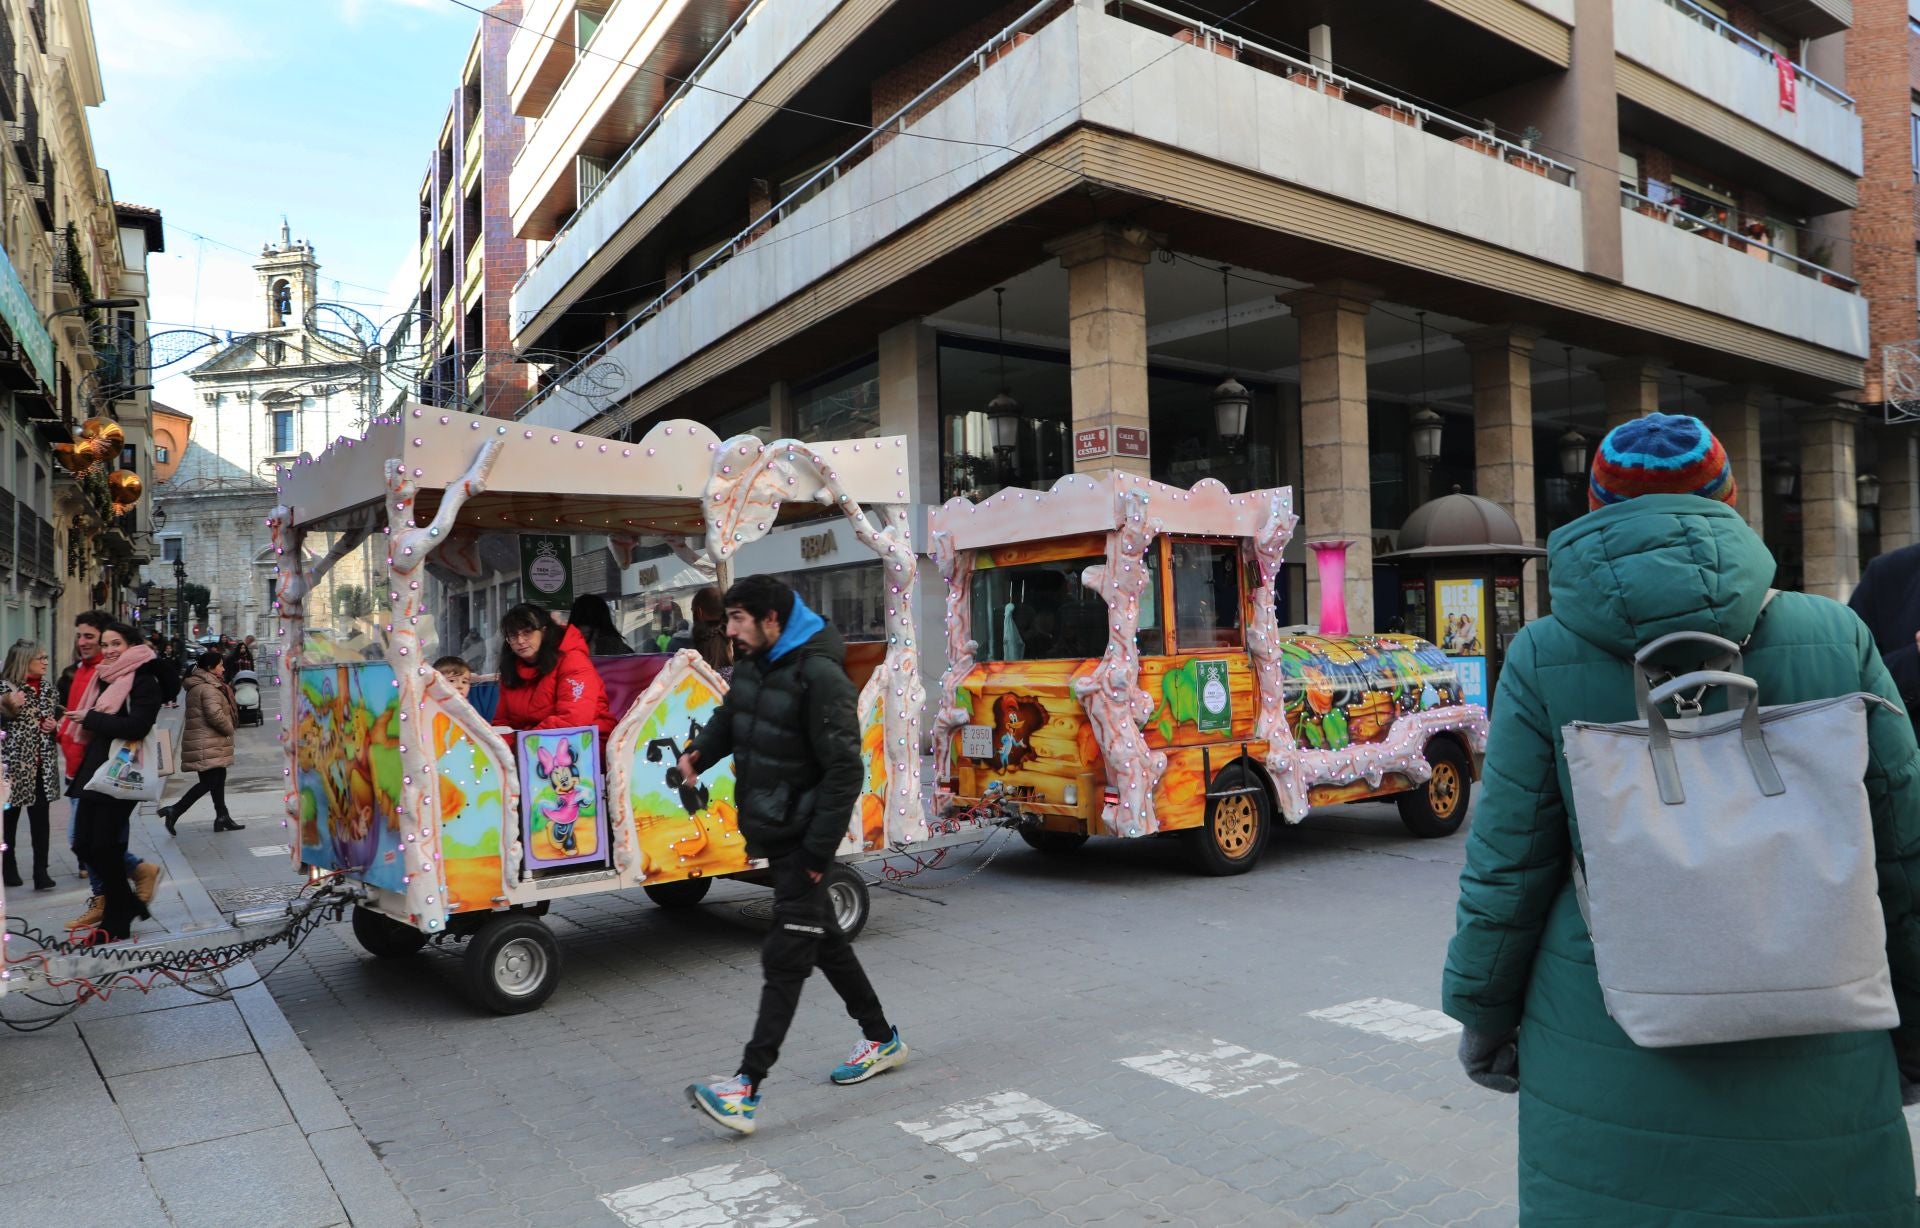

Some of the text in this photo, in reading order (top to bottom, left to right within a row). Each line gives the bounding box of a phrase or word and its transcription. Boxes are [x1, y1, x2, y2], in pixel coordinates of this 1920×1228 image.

[1080, 433, 1096, 441] CALLE
[1077, 446, 1106, 455] CESTILLA
[801, 529, 838, 560] BBVA
[971, 728, 990, 740] 2950
